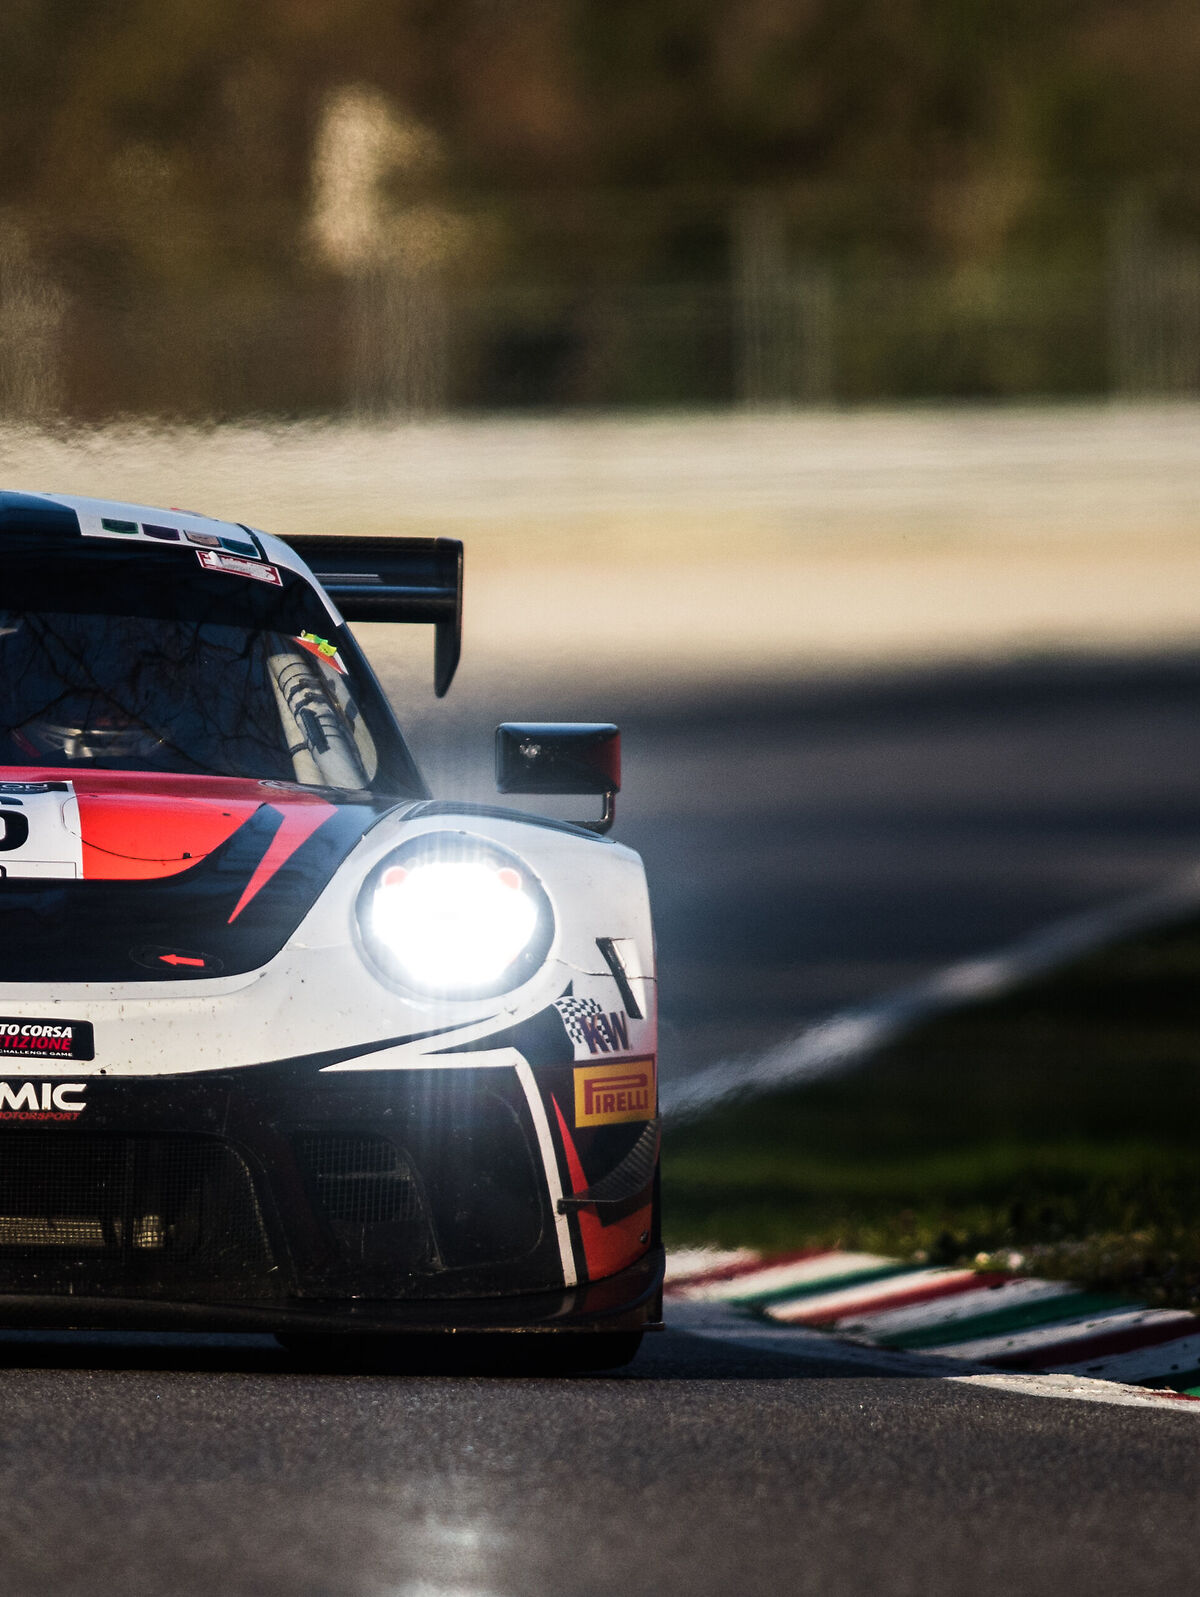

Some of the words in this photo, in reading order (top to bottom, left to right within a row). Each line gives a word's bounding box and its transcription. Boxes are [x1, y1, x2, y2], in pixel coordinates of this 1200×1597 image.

[21, 1024, 73, 1038] CORSA
[579, 1012, 629, 1054] KW
[584, 1073, 649, 1115] PIRELLI
